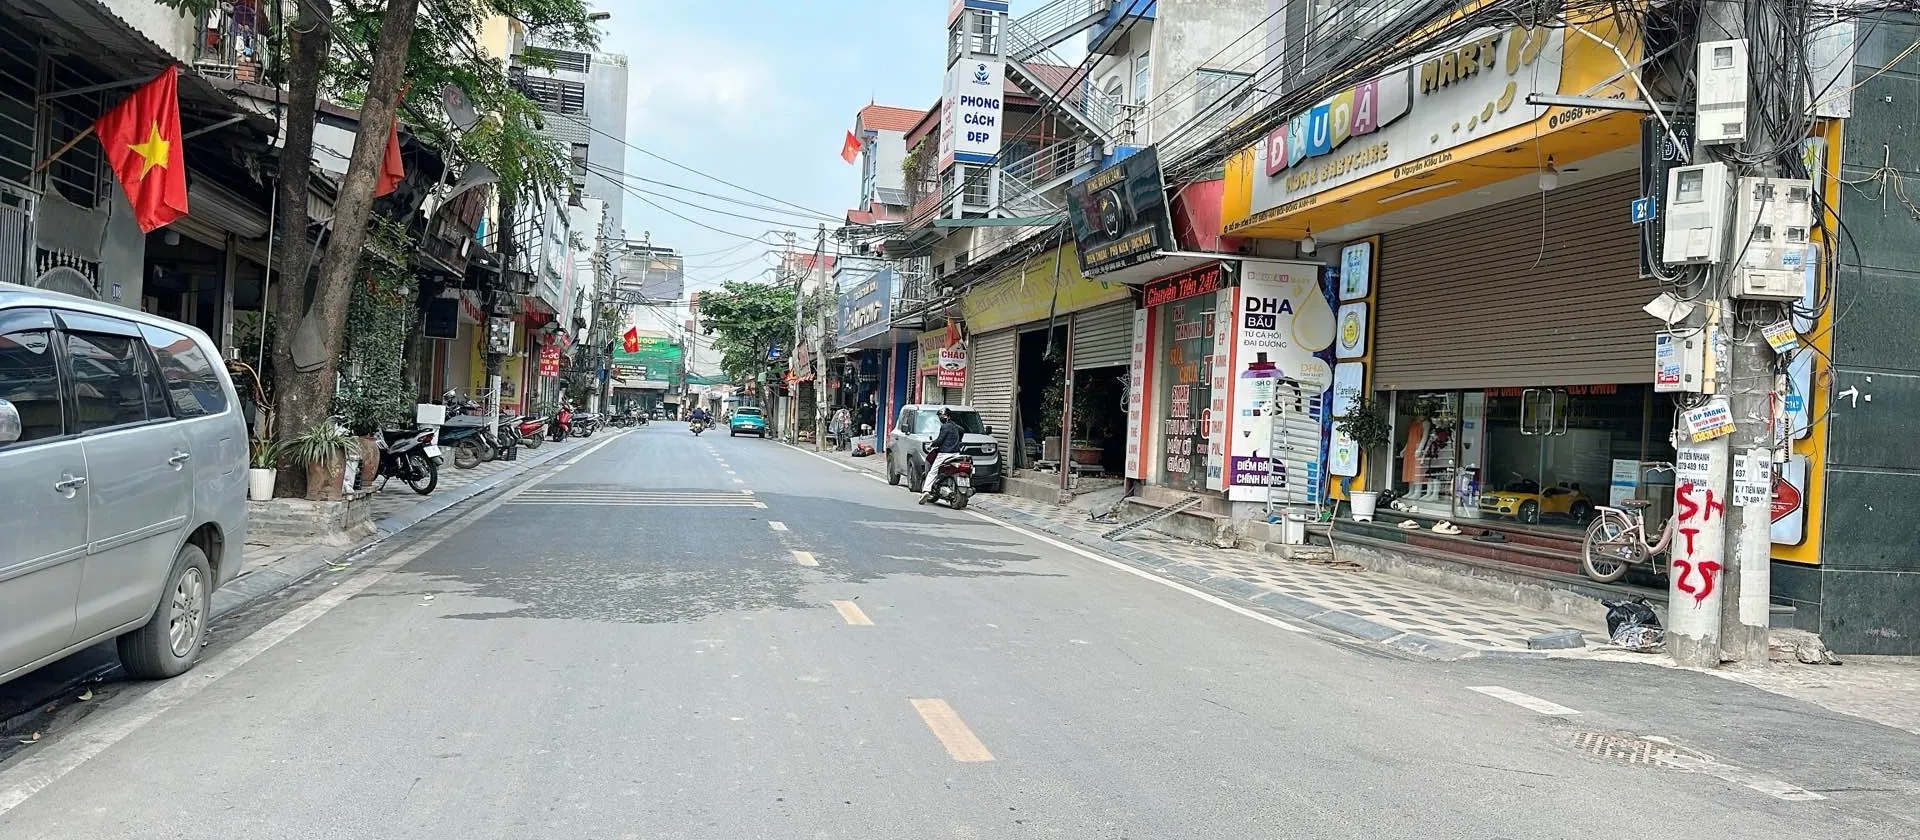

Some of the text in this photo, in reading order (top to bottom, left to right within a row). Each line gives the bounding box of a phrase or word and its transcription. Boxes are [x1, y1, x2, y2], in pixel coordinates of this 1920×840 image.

[1420, 33, 1502, 95] MART
[960, 95, 1000, 110] PHONG
[964, 112, 995, 127] CÁCH
[1559, 107, 1583, 125] 0968
[967, 131, 990, 145] ĐẸP
[1245, 296, 1293, 315] DHA
[1258, 340, 1288, 349] DƯƠNG
[1692, 453, 1710, 461] NHANH
[1735, 459, 1744, 467] VAY
[1237, 458, 1271, 472] ĐIỂM BÁ
[1698, 463, 1709, 471] 163
[1236, 473, 1260, 484] CHÍNH
[1679, 528, 1700, 557] T
[1673, 560, 1724, 602] 25
